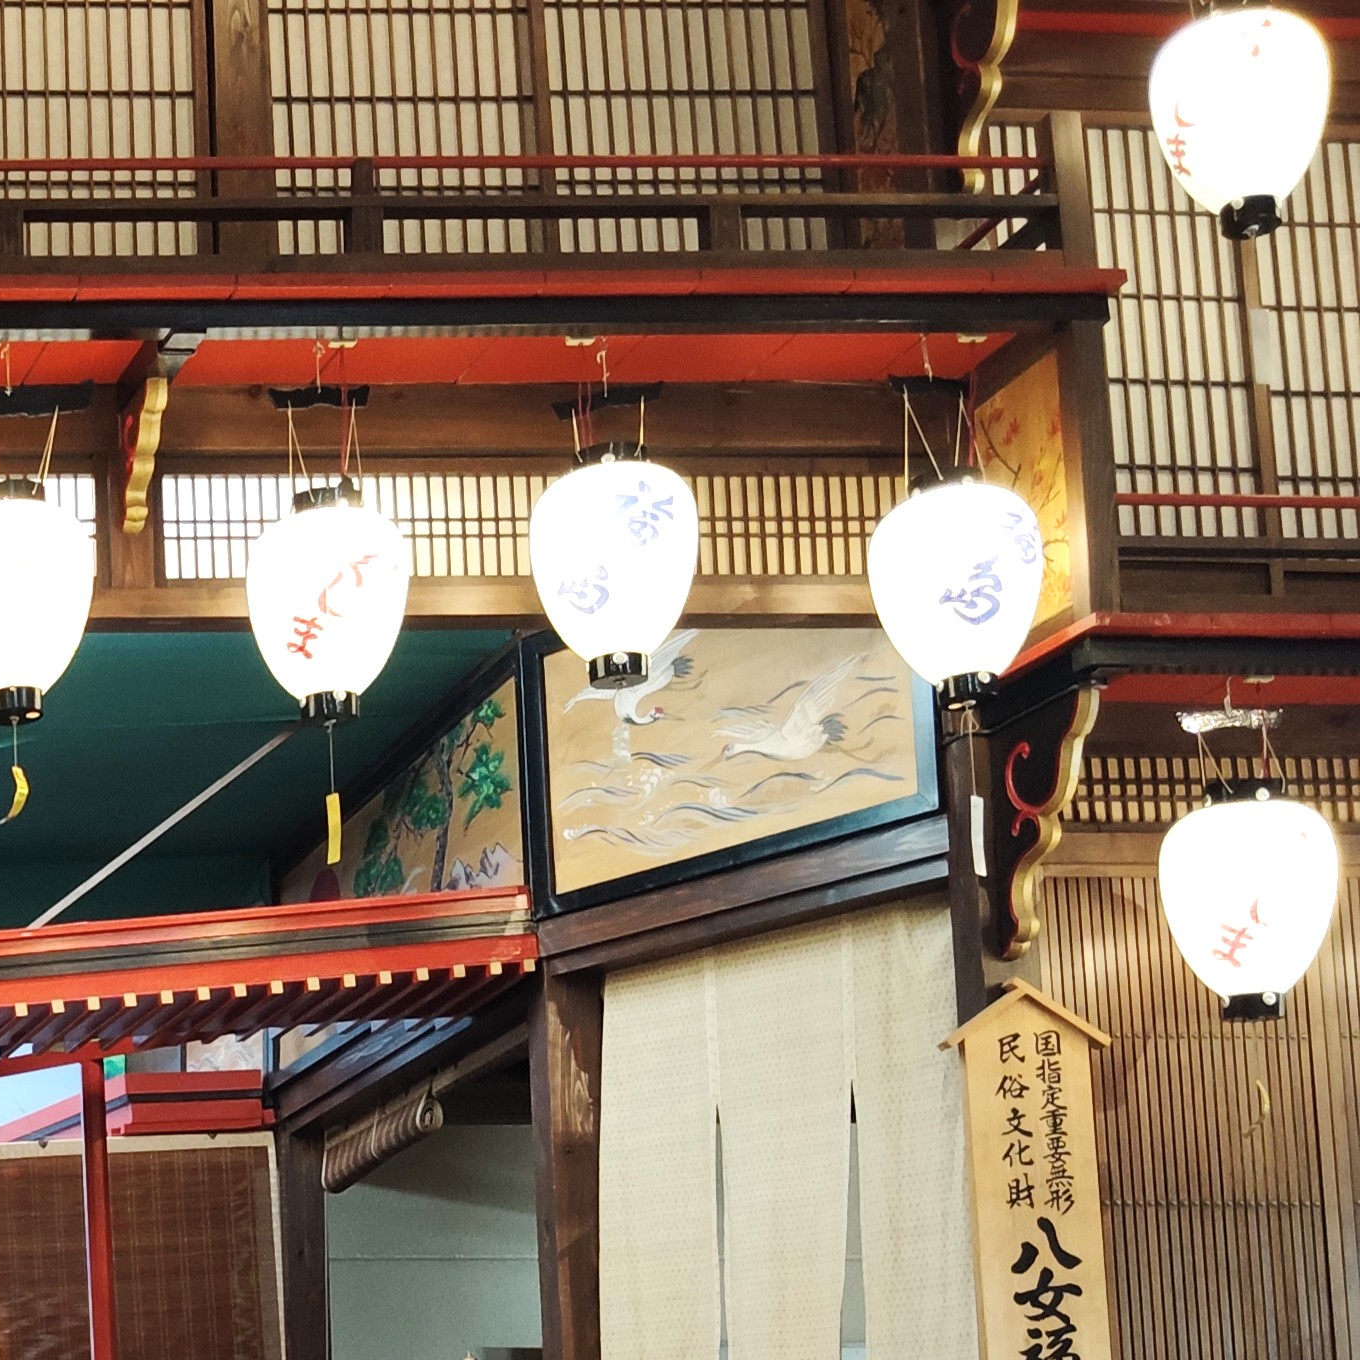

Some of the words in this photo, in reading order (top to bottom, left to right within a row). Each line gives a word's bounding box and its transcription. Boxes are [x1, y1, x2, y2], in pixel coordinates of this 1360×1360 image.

[995, 1032, 1036, 1209] 民俗文化財
[1035, 1029, 1075, 1216] 国指定重要無形
